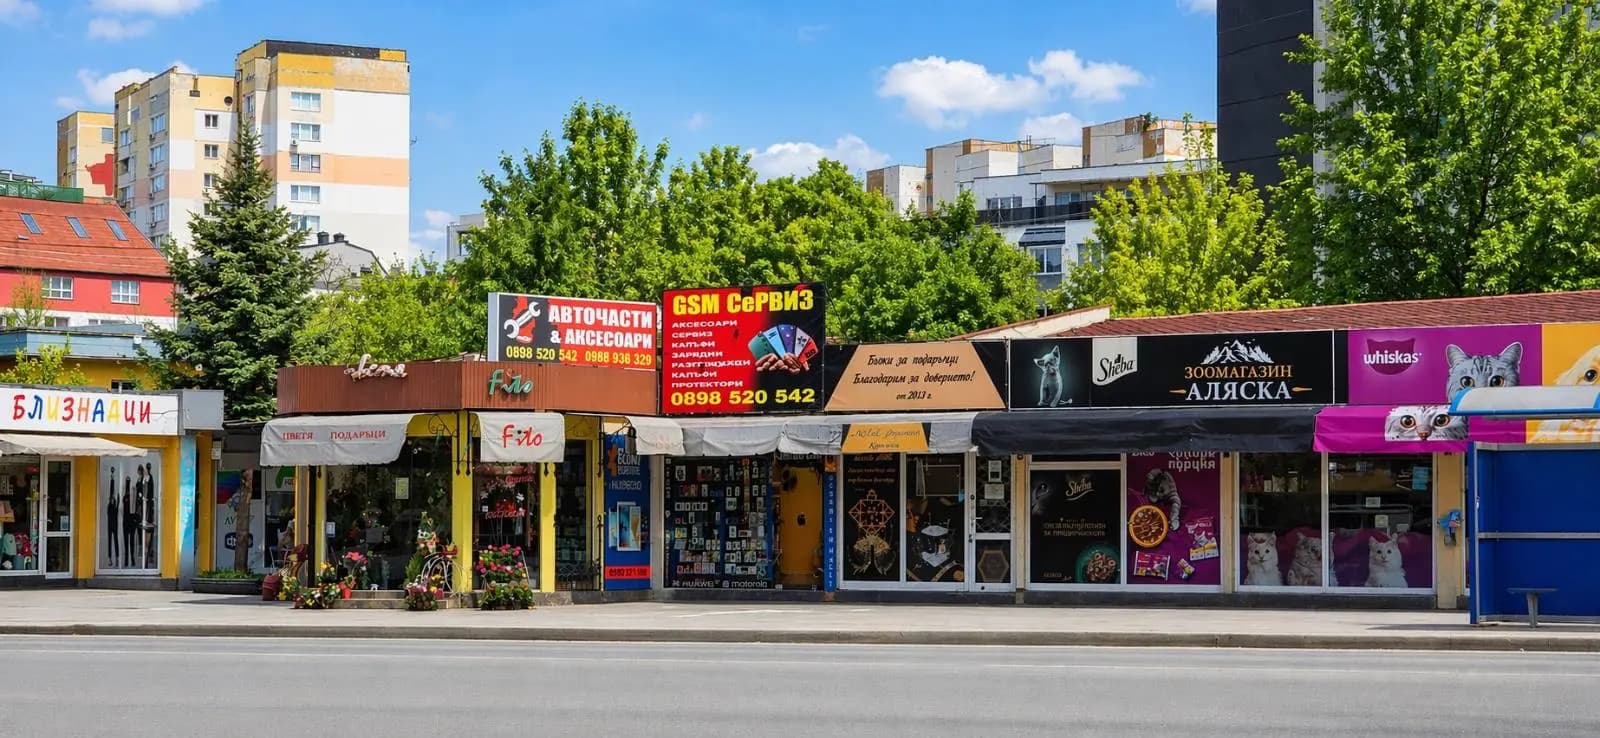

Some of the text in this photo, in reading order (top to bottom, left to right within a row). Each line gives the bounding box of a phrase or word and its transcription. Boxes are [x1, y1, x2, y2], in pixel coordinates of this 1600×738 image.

[672, 293, 720, 316] GSM
[548, 304, 653, 329] АВТОЧАСТИ
[672, 320, 738, 329] АКСЕСОАРИ
[550, 328, 653, 349] & АКСЕСОАРИ
[672, 331, 713, 339] СЕРВИЗ
[506, 345, 652, 366] 0898 520 542 0988 936 329
[896, 356, 907, 367] за
[1363, 350, 1420, 364] whiskas
[1097, 356, 1135, 382] Sheba
[1184, 365, 1293, 379] ЗООМАГАЗИН
[672, 380, 743, 389] ПРОТЕКТОРИ
[853, 370, 976, 386] Благодарим за доверието!
[670, 388, 816, 407] 0898 520 542
[907, 390, 927, 400] 2013
[1185, 381, 1292, 401] АЛЯСКА
[330, 429, 387, 441] ПОДАРЪЦИ
[731, 580, 768, 588] motorola
